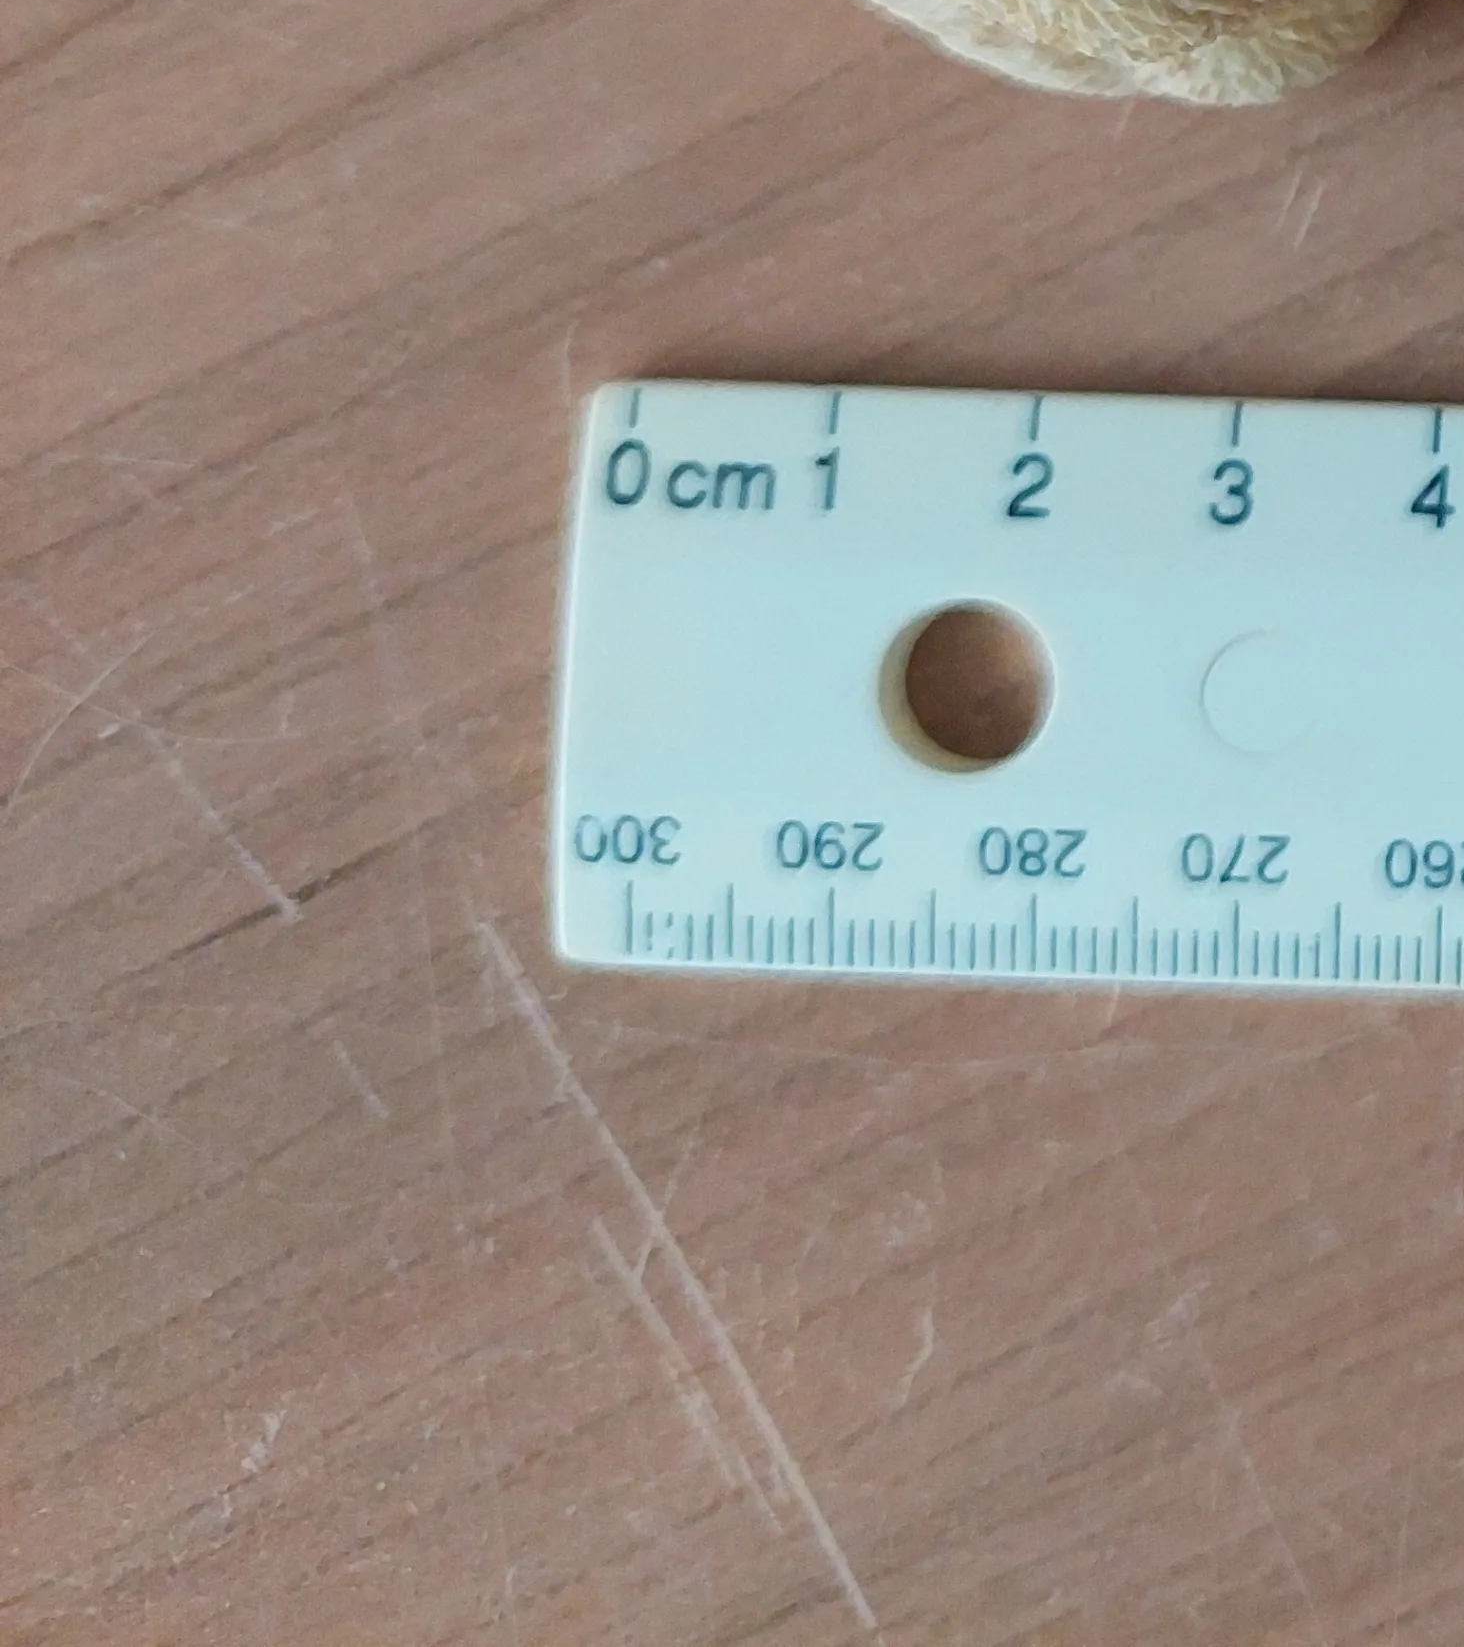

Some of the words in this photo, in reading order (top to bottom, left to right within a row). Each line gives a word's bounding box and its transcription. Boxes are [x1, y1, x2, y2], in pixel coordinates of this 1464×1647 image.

[814, 447, 841, 511] 1
[1004, 453, 1054, 520] 2
[1208, 459, 1254, 527] 3
[1408, 465, 1456, 529] 4
[575, 813, 681, 865] 300
[776, 820, 884, 871] 290
[978, 827, 1087, 878] 280
[1181, 833, 1290, 885] 270
